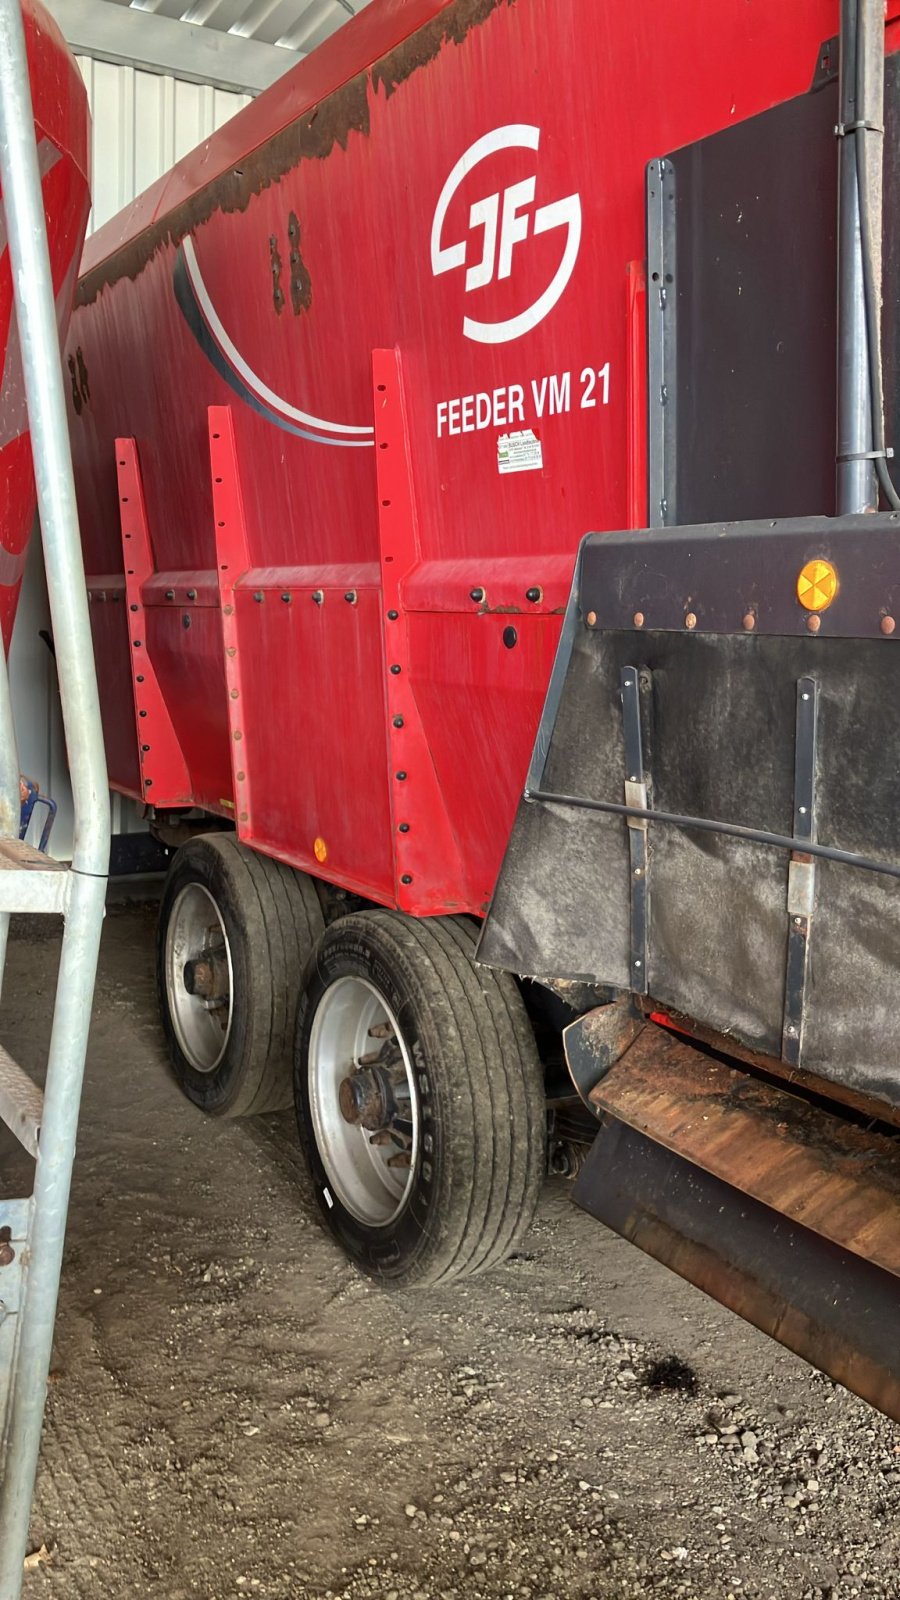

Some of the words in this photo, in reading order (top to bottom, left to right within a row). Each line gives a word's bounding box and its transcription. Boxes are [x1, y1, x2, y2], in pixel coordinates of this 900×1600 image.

[465, 175, 537, 292] JF
[436, 383, 525, 438] FEEDER
[531, 371, 571, 418] VM
[580, 362, 610, 409] 21
